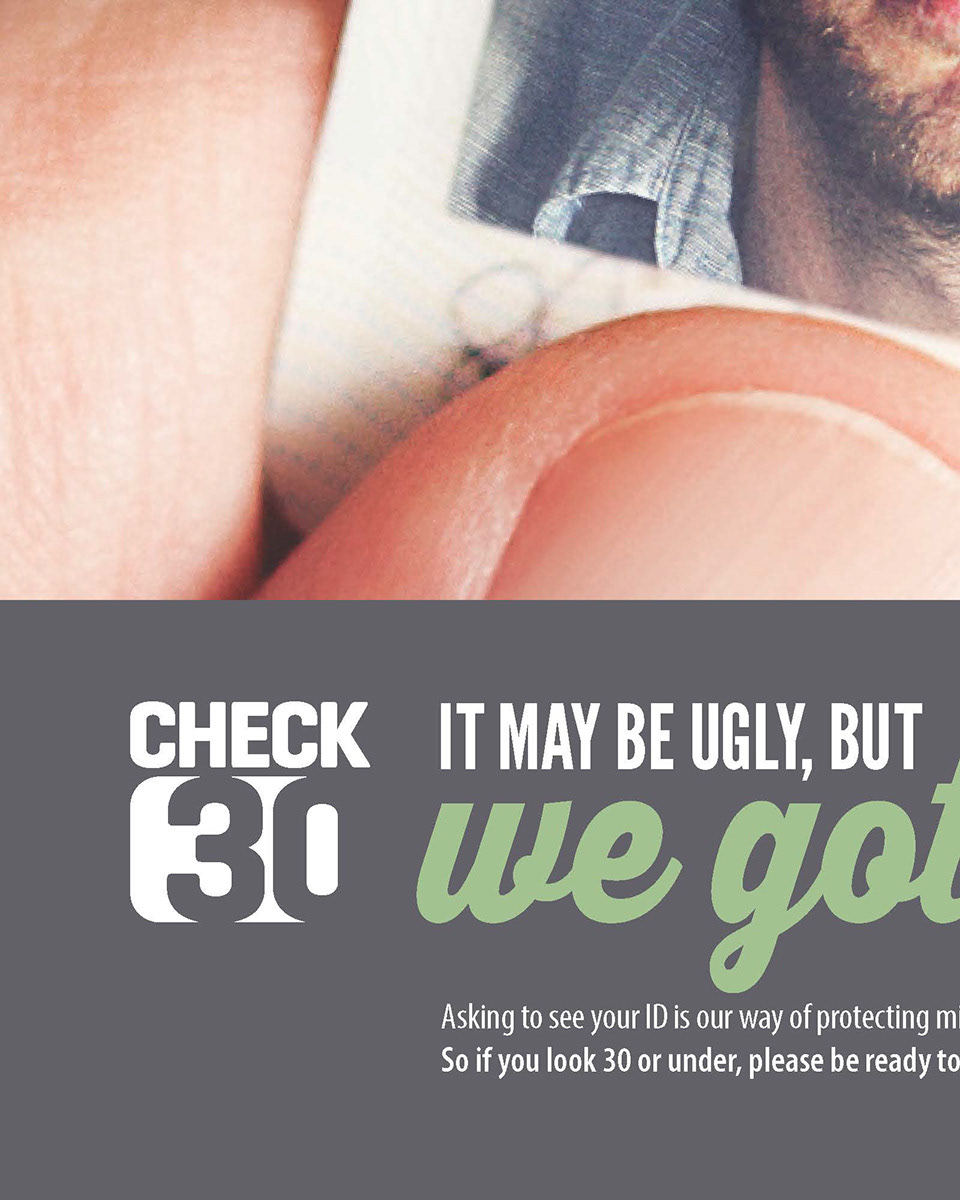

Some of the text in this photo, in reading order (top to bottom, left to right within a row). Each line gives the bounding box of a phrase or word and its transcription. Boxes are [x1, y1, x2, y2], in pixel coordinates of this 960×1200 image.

[129, 701, 370, 769] CHECK
[441, 702, 923, 781] IT MAY BE UGLY, BUT
[166, 776, 338, 923] 30
[416, 800, 683, 924] we
[441, 1003, 514, 1036] Asking
[521, 1006, 542, 1030] to
[549, 1009, 584, 1030] see
[591, 1009, 640, 1036] your
[646, 1004, 667, 1030] ID
[674, 1004, 690, 1030] is
[697, 1009, 733, 1030] our
[739, 1009, 783, 1036] way
[790, 1003, 813, 1030] of
[817, 1004, 929, 1036] protecting
[441, 1047, 468, 1073] So
[476, 1046, 493, 1073] if
[498, 1053, 538, 1080] you
[547, 1046, 597, 1073] look
[603, 1047, 632, 1073] 30
[638, 1053, 662, 1073] or
[668, 1046, 742, 1077] under,
[749, 1046, 824, 1080] please
[831, 1046, 860, 1073] be
[866, 1046, 932, 1080] ready
[937, 1049, 960, 1073] to
